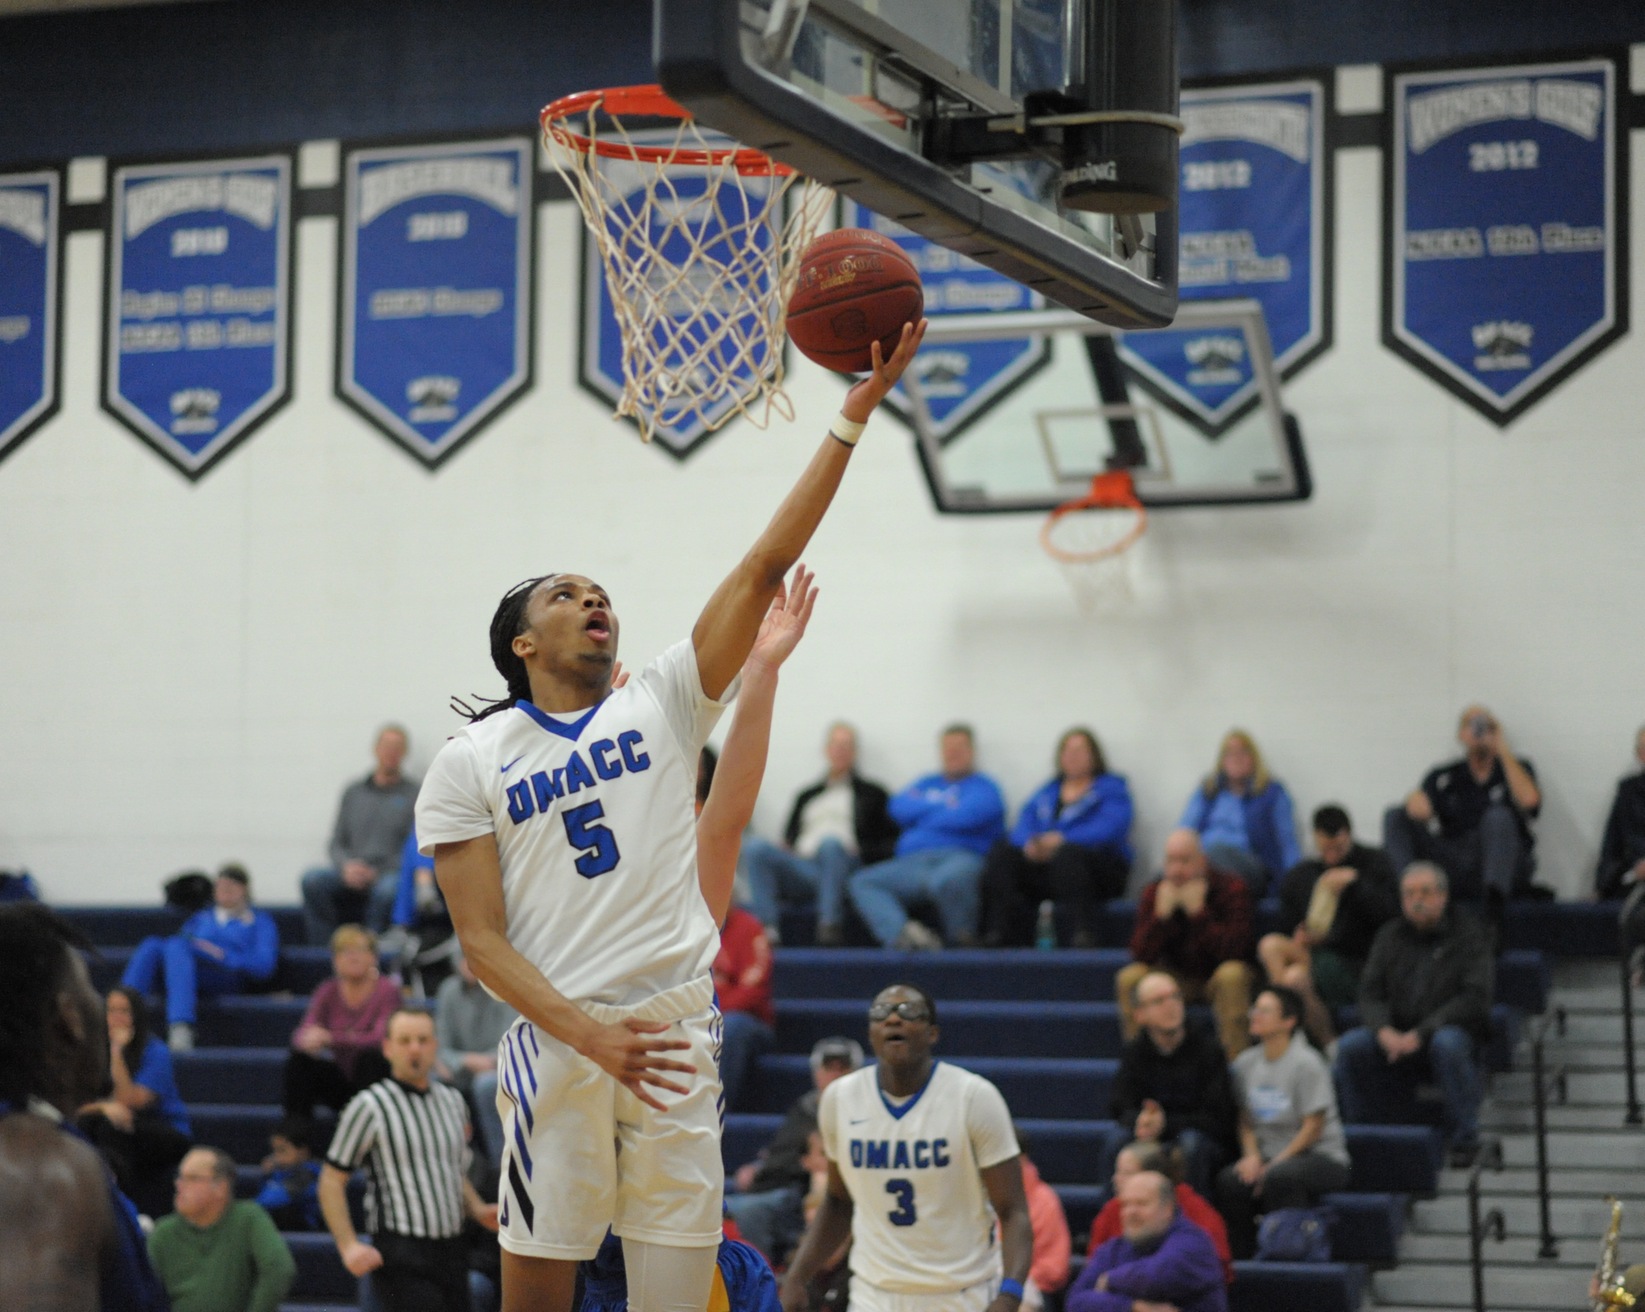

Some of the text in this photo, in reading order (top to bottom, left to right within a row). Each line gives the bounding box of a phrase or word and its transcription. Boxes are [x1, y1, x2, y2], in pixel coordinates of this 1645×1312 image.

[1468, 139, 1539, 172] 2012
[506, 729, 651, 826] DMACC
[561, 798, 621, 880] 5
[850, 1138, 950, 1169] DMACC
[885, 1178, 918, 1227] 3
